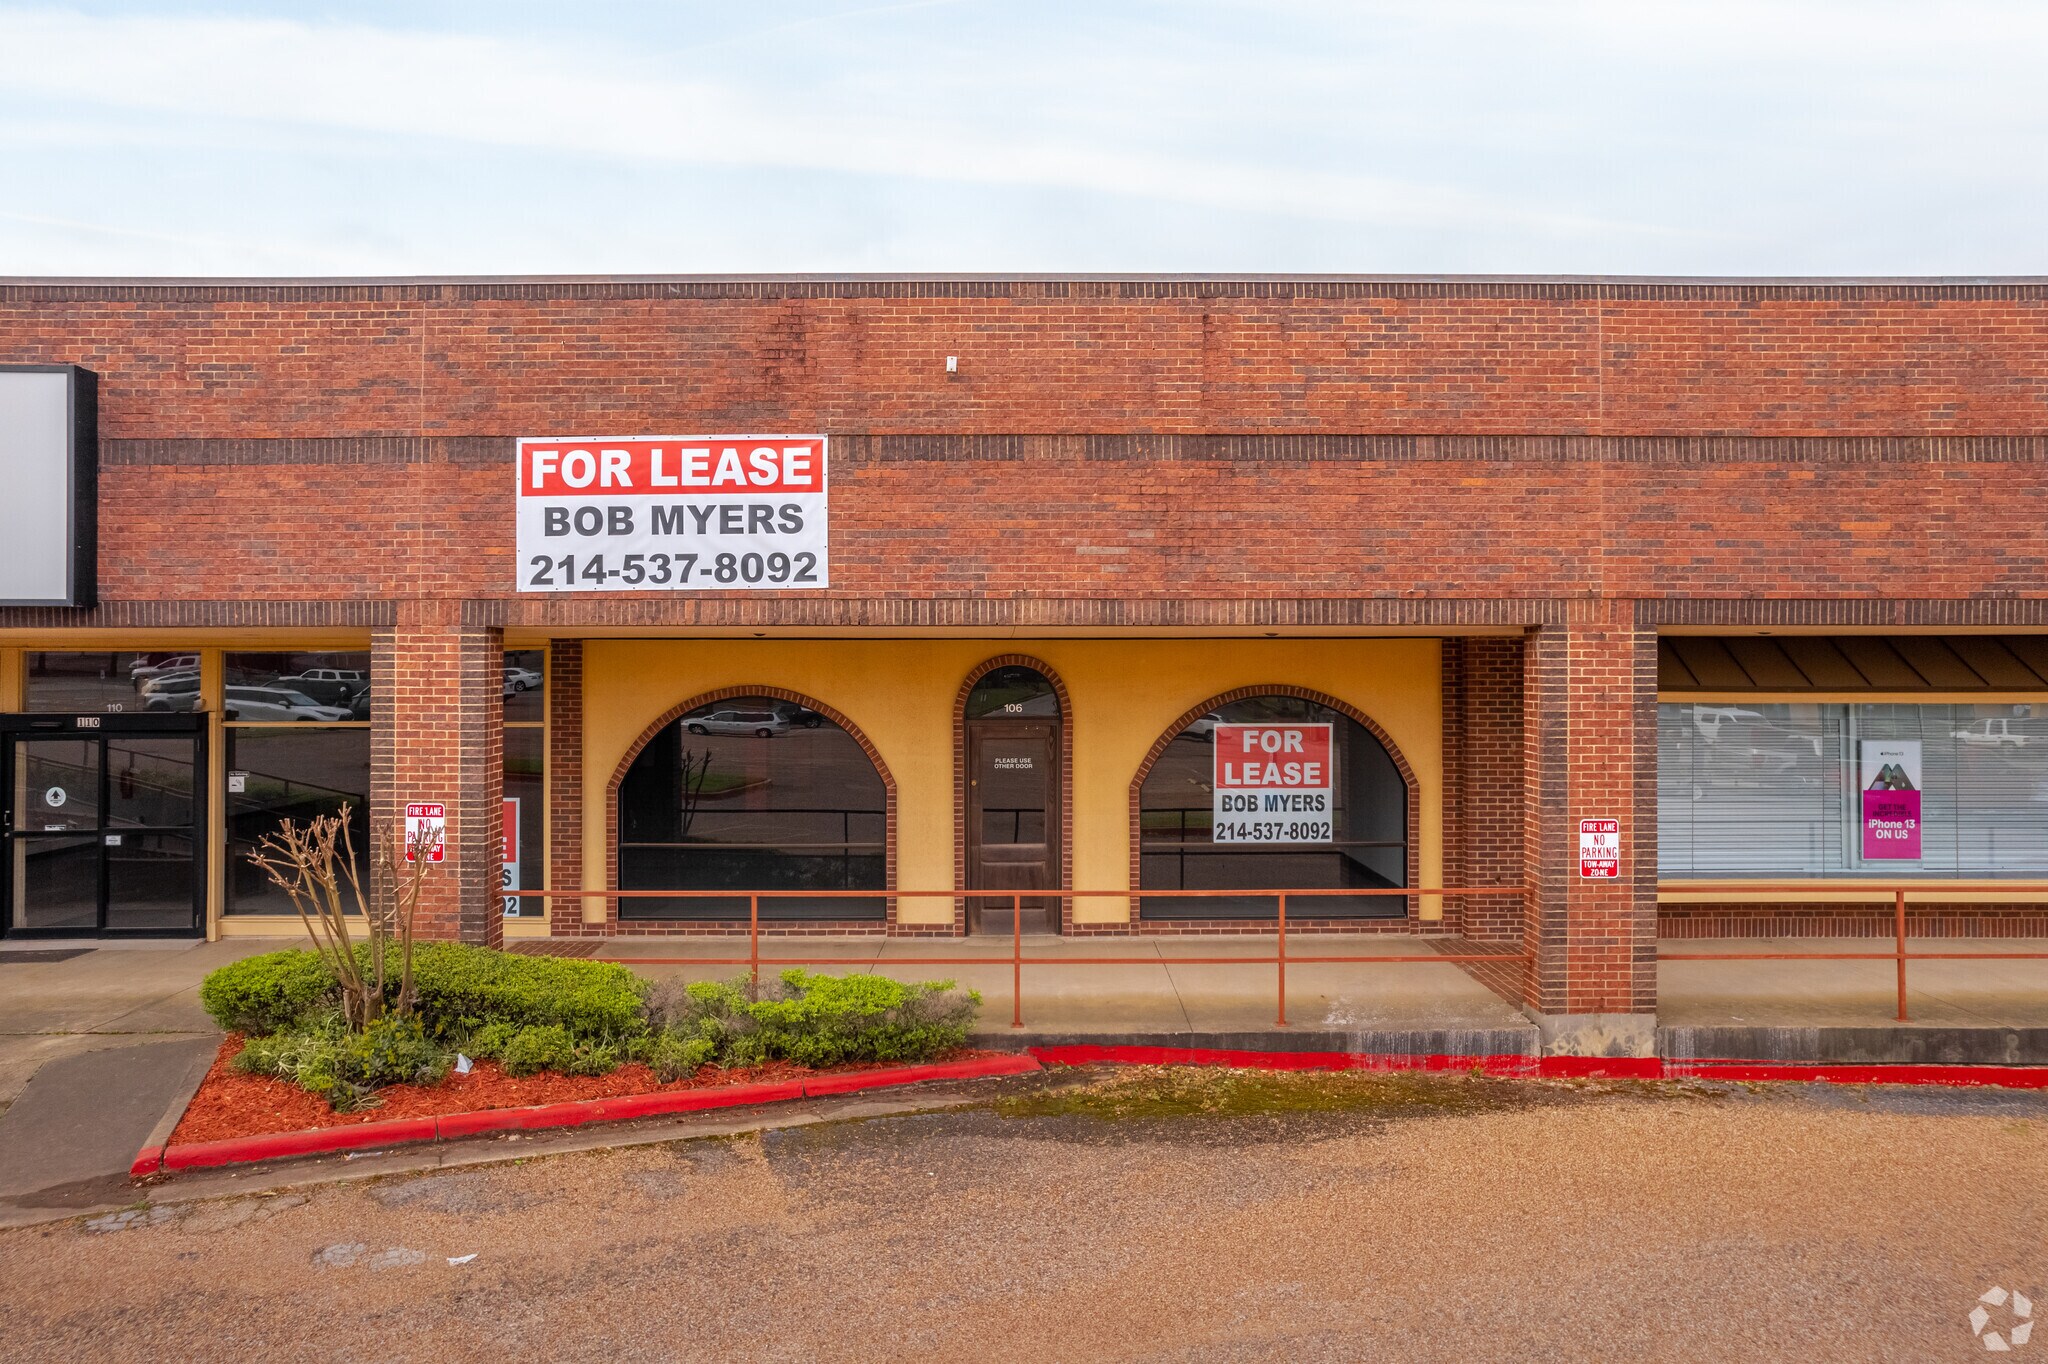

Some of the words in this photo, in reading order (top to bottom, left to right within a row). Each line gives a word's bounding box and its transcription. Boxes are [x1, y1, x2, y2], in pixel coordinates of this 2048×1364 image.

[532, 449, 633, 489] FOR
[651, 446, 812, 487] LEASE
[544, 505, 635, 537] BOB
[651, 503, 804, 535] MYERS
[530, 551, 818, 586] 214-537-8092
[107, 703, 123, 712] 110
[1004, 703, 1023, 713] 106
[79, 718, 99, 727] 110
[1243, 730, 1304, 753] FOR
[1225, 762, 1321, 785] LEASE
[1222, 794, 1259, 812] BOB
[1264, 794, 1325, 812] MYERS
[409, 806, 424, 815] FIRE
[425, 806, 442, 815] LANE
[1583, 822, 1597, 831] FIRE
[1599, 822, 1616, 831] LANE
[1868, 819, 1902, 829] iPhone
[1904, 819, 1916, 829] 13
[1216, 822, 1330, 840] 214-537-8092
[1875, 829, 1892, 839] ON
[1895, 829, 1909, 839] US
[1593, 834, 1605, 846] NO
[1582, 846, 1617, 858] PARKING
[1583, 860, 1616, 868] TOW-AWAY
[1590, 868, 1609, 876] ZONE
